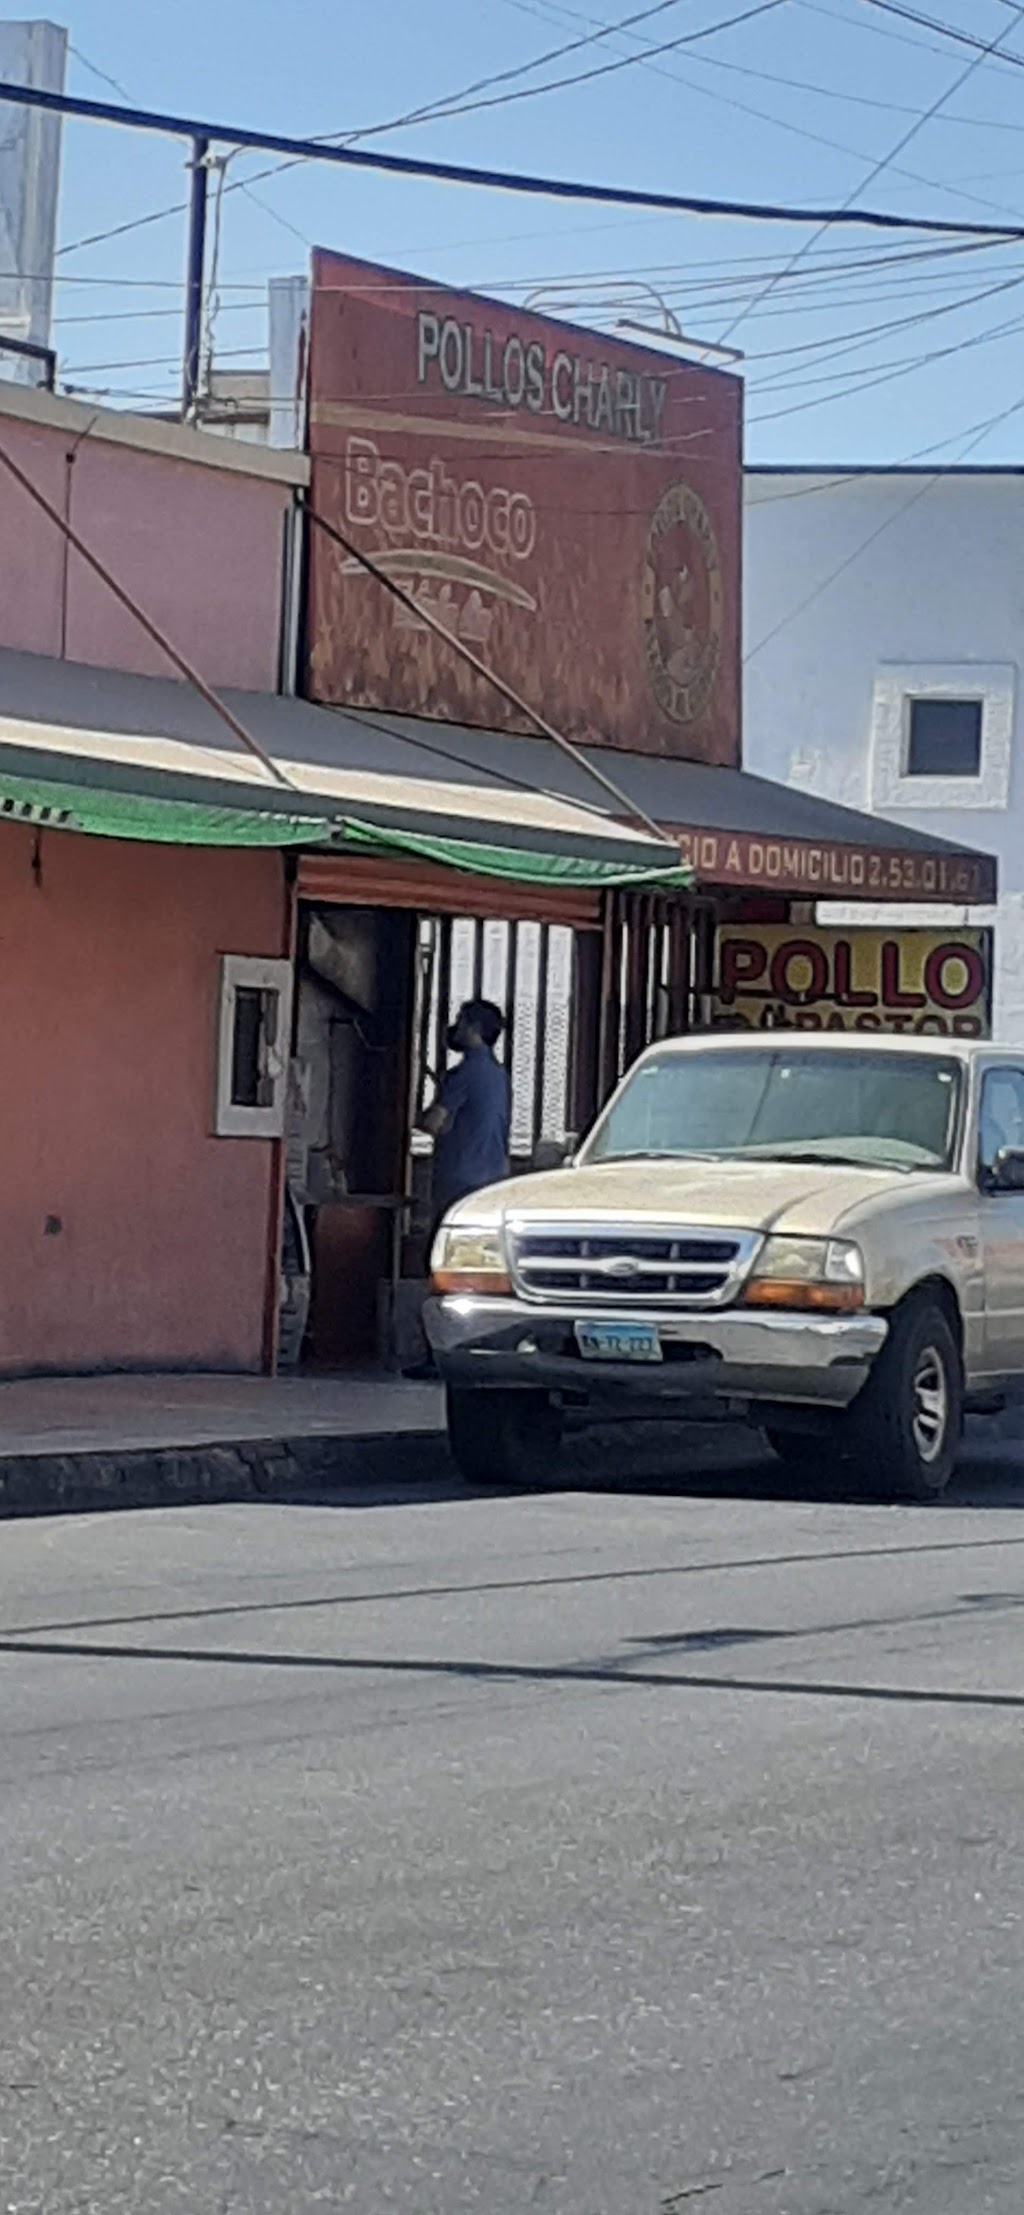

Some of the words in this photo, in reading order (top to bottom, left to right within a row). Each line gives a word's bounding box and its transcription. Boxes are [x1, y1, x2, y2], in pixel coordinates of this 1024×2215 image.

[418, 311, 545, 414] POLLOS
[551, 350, 668, 446] CHARLY
[345, 436, 536, 560] Bachoco
[724, 839, 741, 873] A
[748, 843, 865, 886] DOMICILIO
[719, 938, 985, 1010] POLLO
